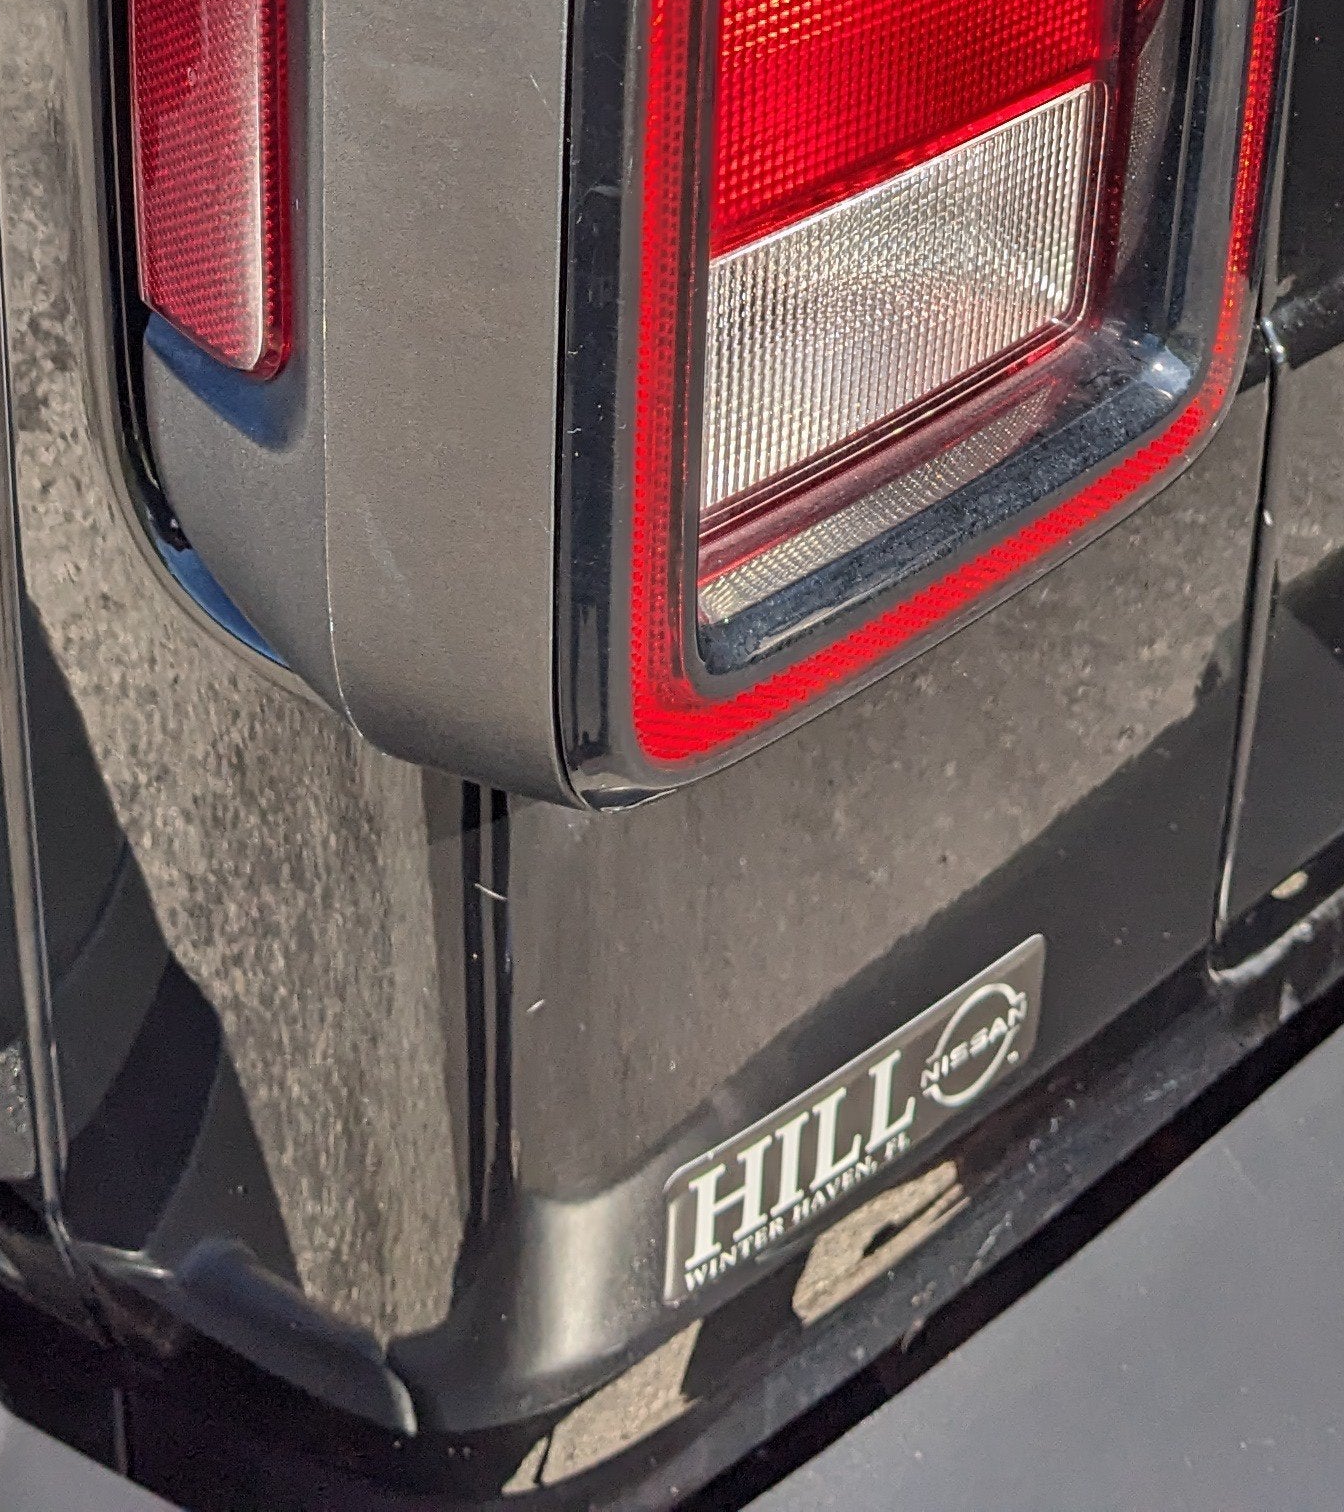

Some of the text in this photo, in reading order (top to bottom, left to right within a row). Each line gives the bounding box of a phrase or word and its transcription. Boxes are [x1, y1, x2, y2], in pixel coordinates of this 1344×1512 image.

[920, 996, 1027, 1088] NISSAN
[684, 1050, 916, 1271] HILL
[684, 1216, 784, 1291] WINTER
